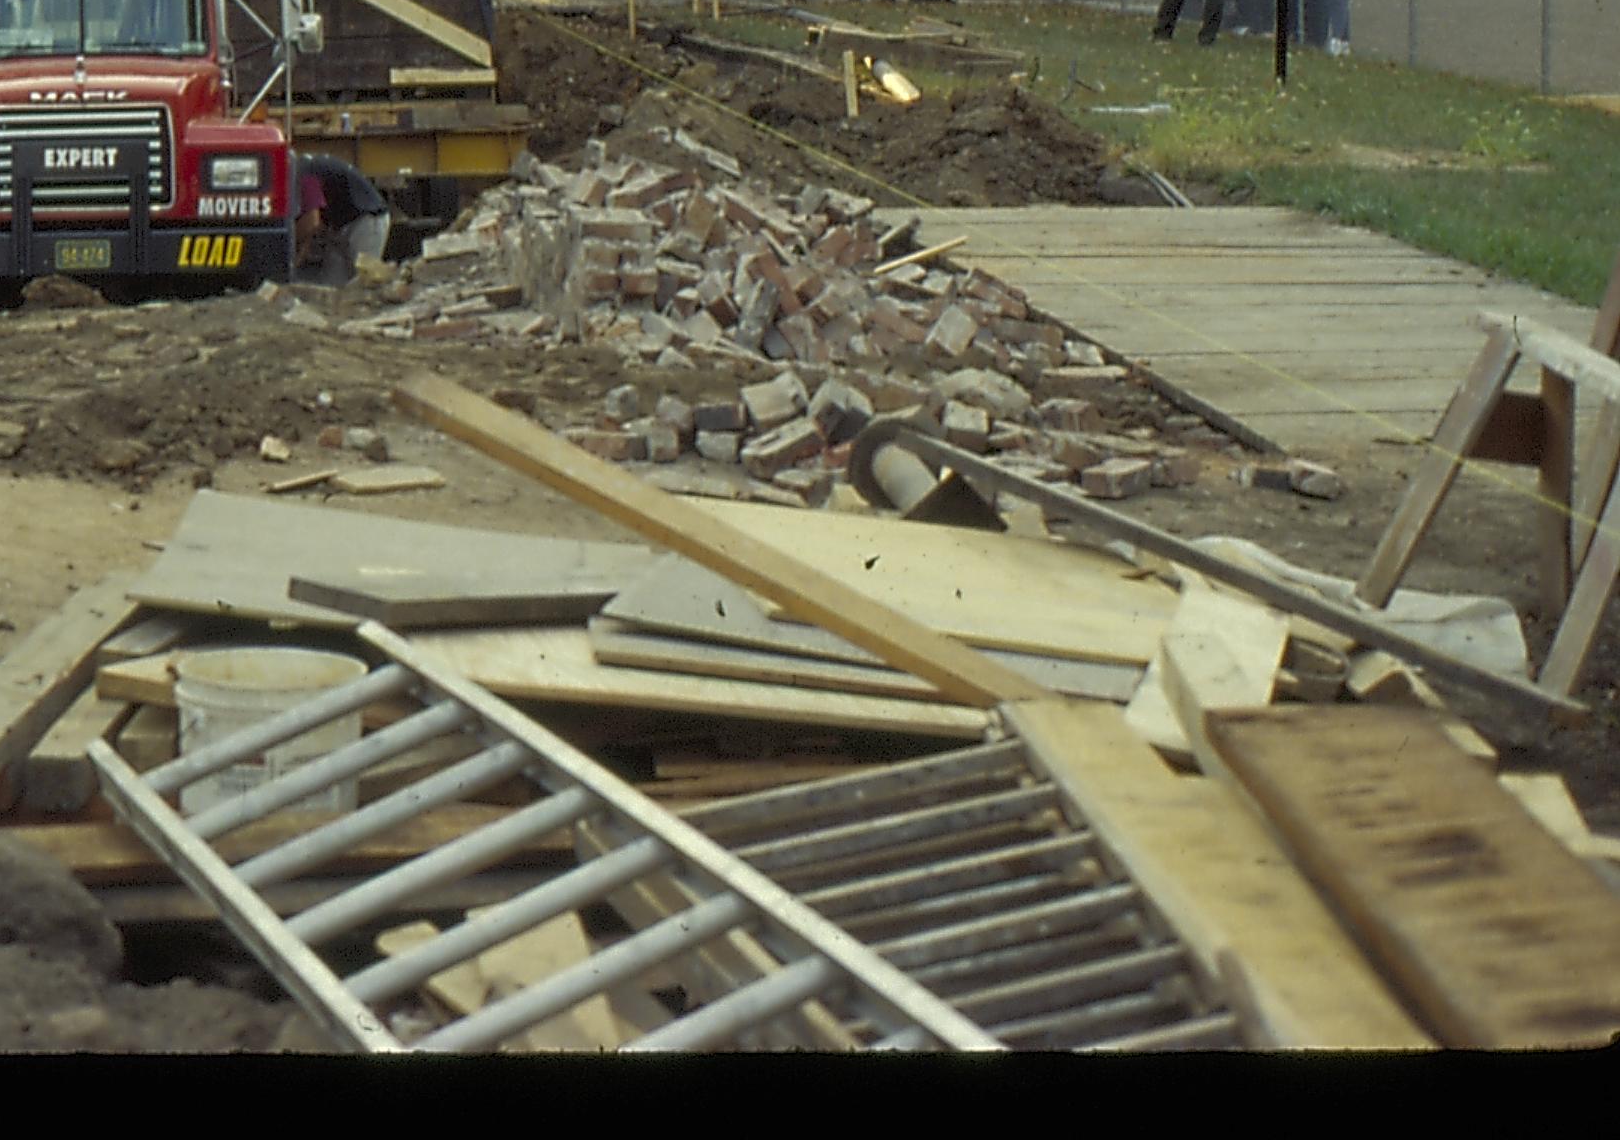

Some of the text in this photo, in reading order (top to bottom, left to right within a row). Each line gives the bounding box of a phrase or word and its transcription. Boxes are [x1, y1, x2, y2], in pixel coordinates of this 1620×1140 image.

[44, 147, 118, 168] EXPERT
[198, 197, 271, 216] MOVERS
[178, 235, 244, 267] LOAD
